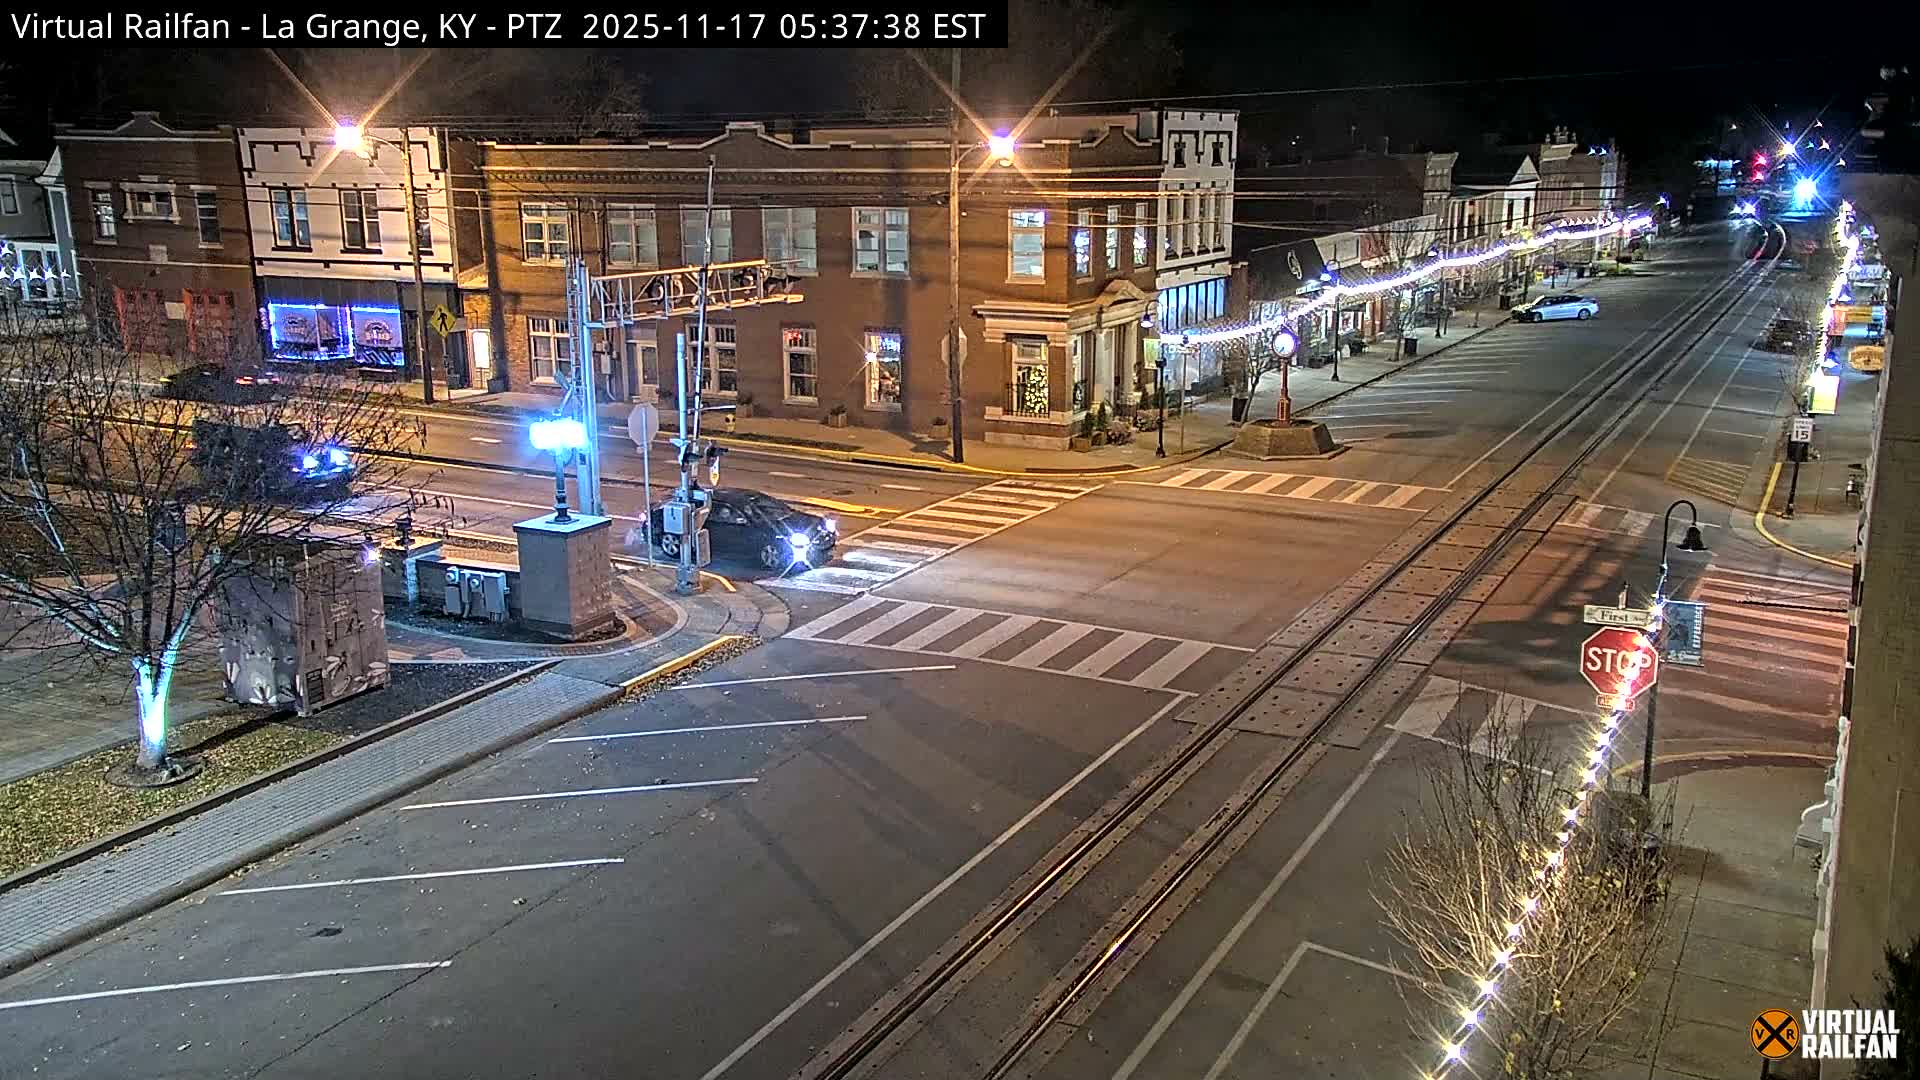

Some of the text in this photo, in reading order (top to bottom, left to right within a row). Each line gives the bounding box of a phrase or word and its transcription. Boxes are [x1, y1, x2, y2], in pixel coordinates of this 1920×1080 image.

[1796, 430, 1808, 440] 15
[1601, 610, 1628, 622] First
[1587, 646, 1652, 674] STOP
